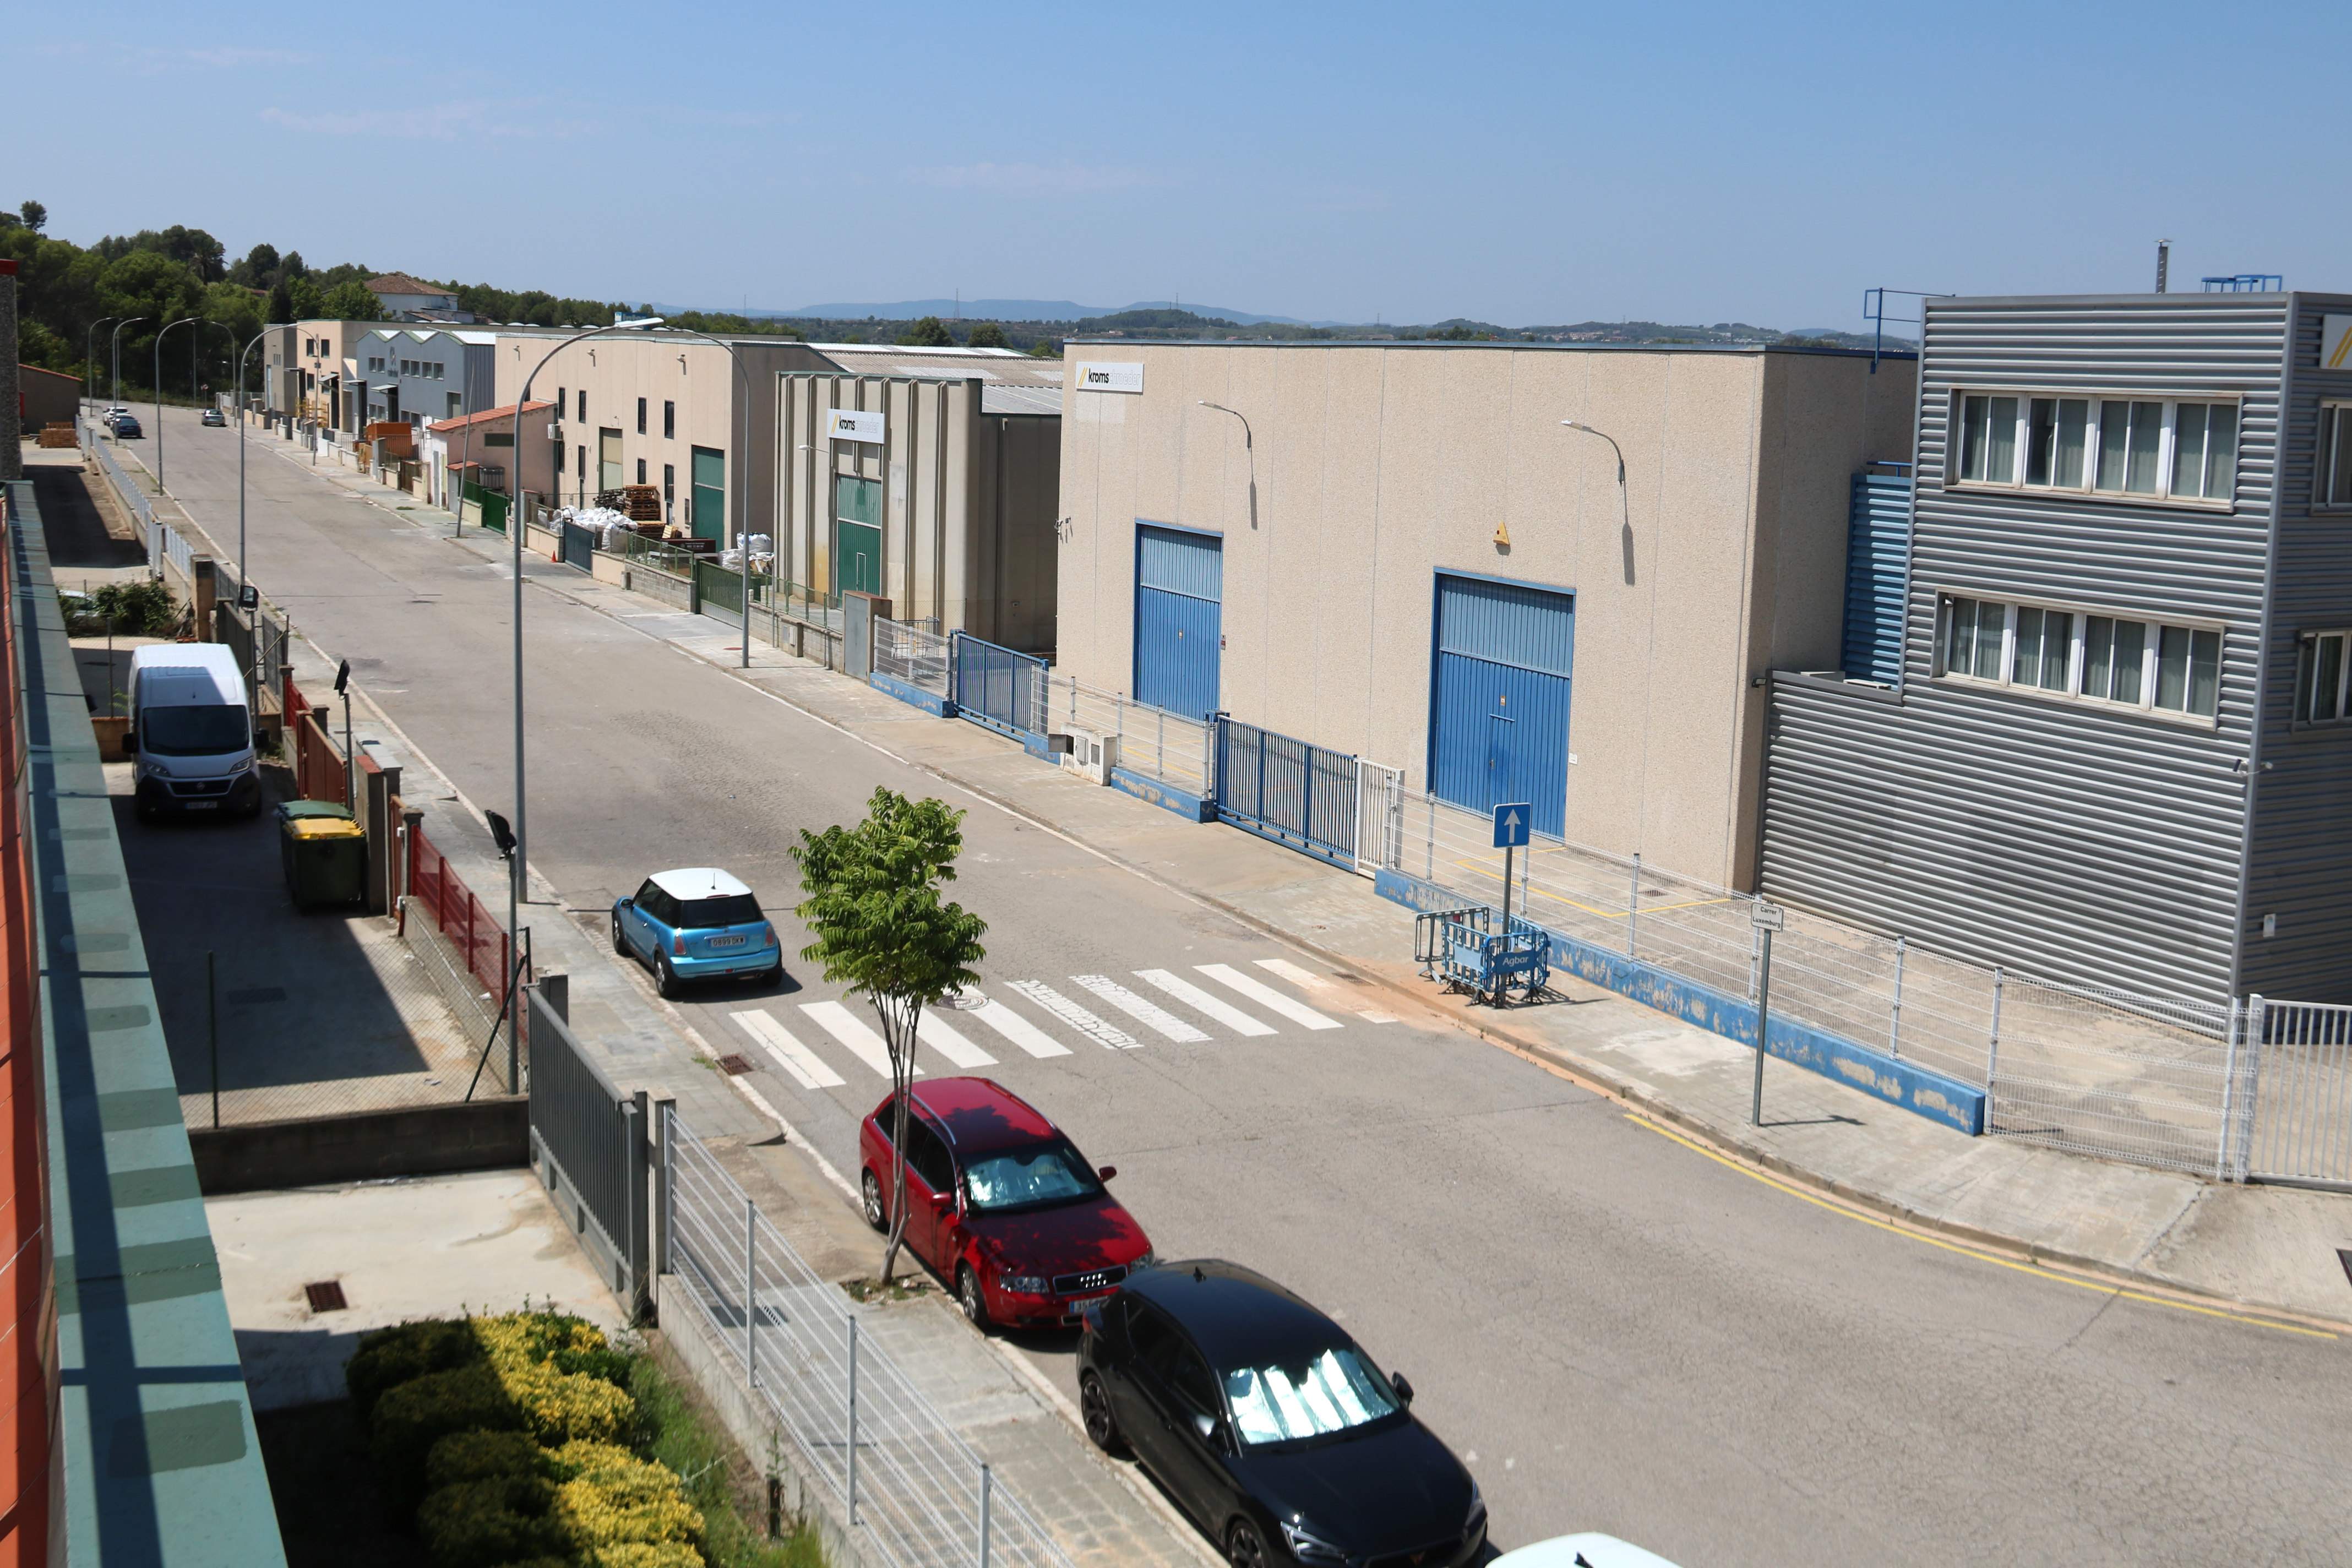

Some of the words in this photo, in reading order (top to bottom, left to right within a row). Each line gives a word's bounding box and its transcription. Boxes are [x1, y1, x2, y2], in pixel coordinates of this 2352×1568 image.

[1760, 906, 1777, 915] Carrer
[1752, 916, 1781, 929] Luxemburg
[1502, 956, 1529, 967] Agbar
